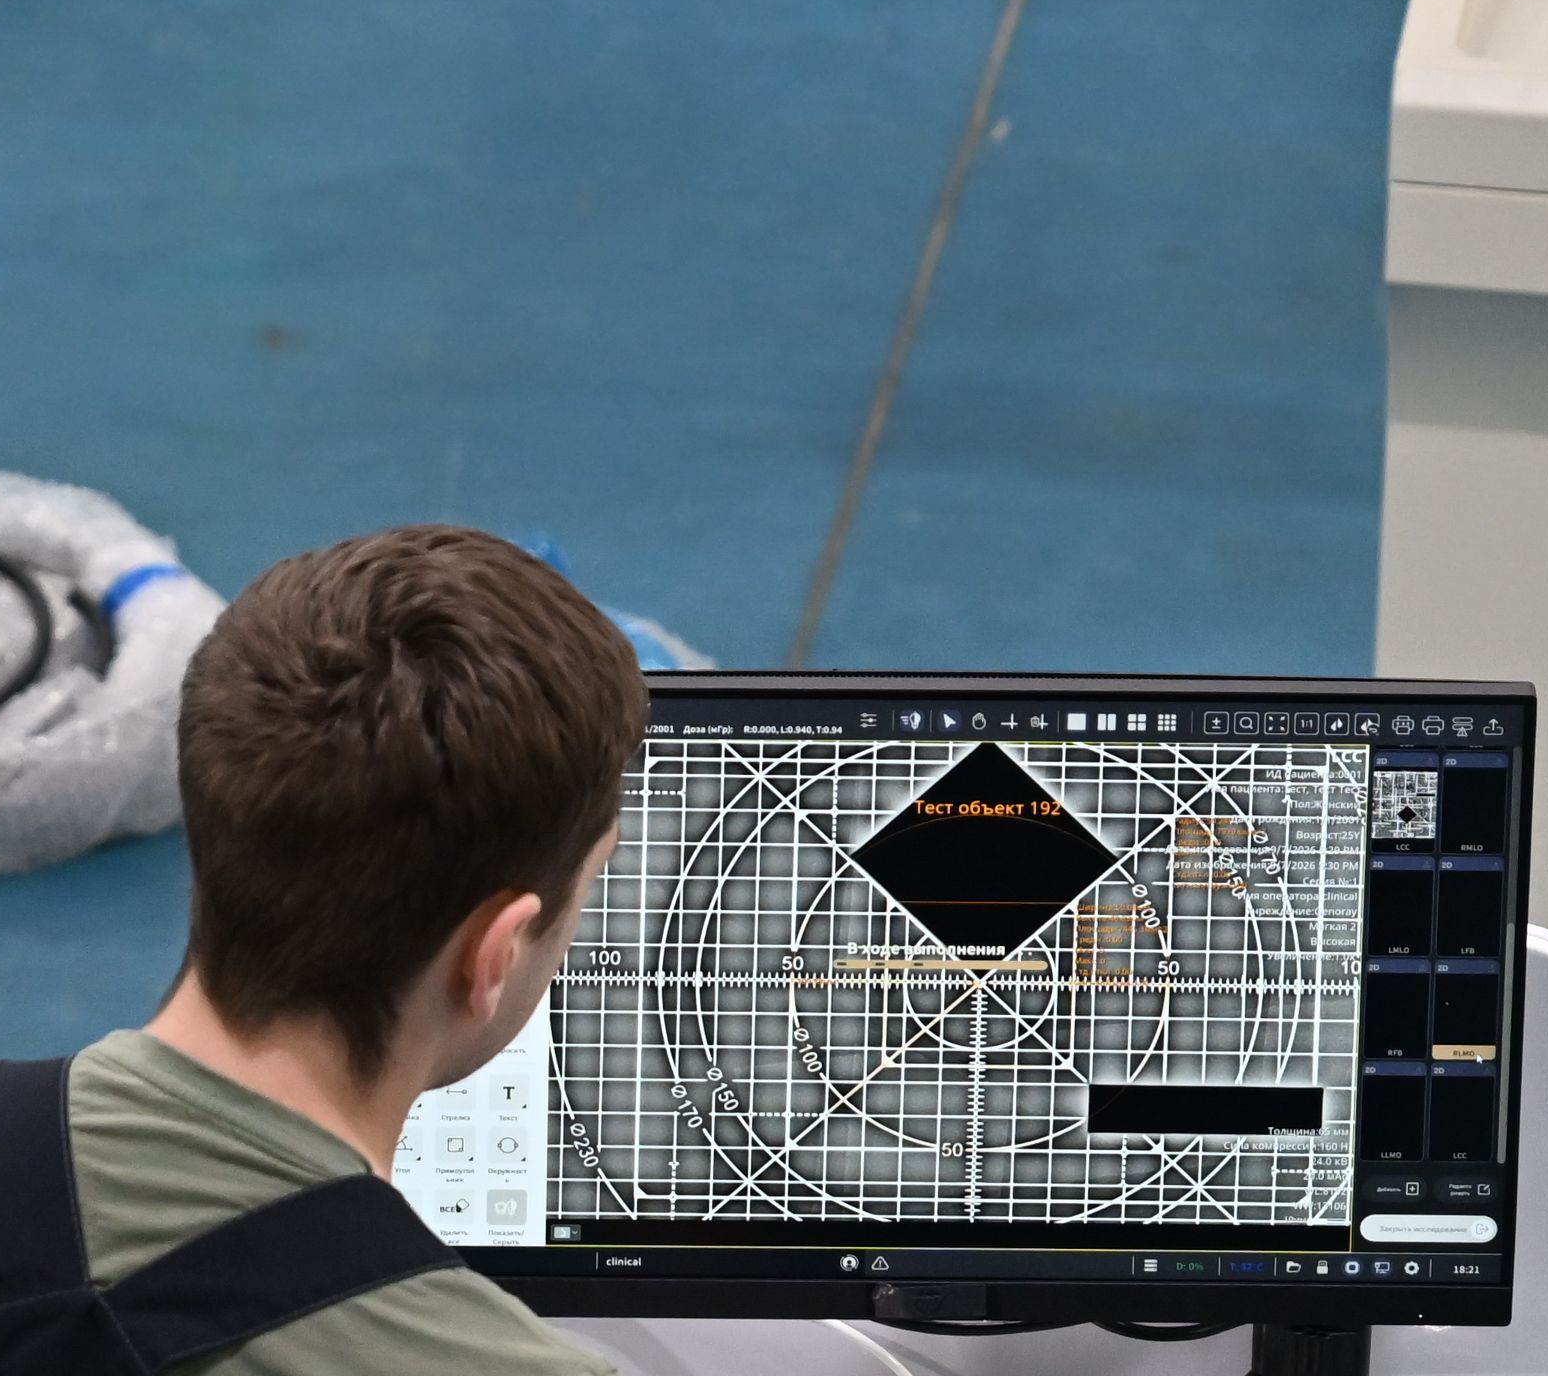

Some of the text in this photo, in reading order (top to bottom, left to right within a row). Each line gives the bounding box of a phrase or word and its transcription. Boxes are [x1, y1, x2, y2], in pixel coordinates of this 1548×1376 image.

[683, 725, 706, 735] Доза
[707, 725, 734, 736] (мГр):
[743, 726, 779, 735] R:0.000,
[816, 726, 843, 735] T:0.94
[1376, 757, 1388, 765] 2D
[915, 800, 1061, 816] Тест объект 192
[1395, 843, 1411, 851] LCC
[1460, 844, 1484, 852] RMLO
[1342, 861, 1359, 870] PM
[1372, 860, 1384, 868] 2D
[1441, 861, 1453, 869] 2D
[862, 943, 899, 957] ходе
[1388, 946, 1410, 954] LMLO
[589, 950, 622, 966] 100
[781, 956, 804, 971] 50
[1157, 960, 1180, 976] 50
[1437, 964, 1449, 972] 2D
[1365, 1066, 1376, 1074] 2D
[941, 1142, 964, 1158] 50
[1453, 1152, 1467, 1160] LCC
[606, 1256, 642, 1267] clinical
[1453, 1265, 1480, 1274] 18:21
